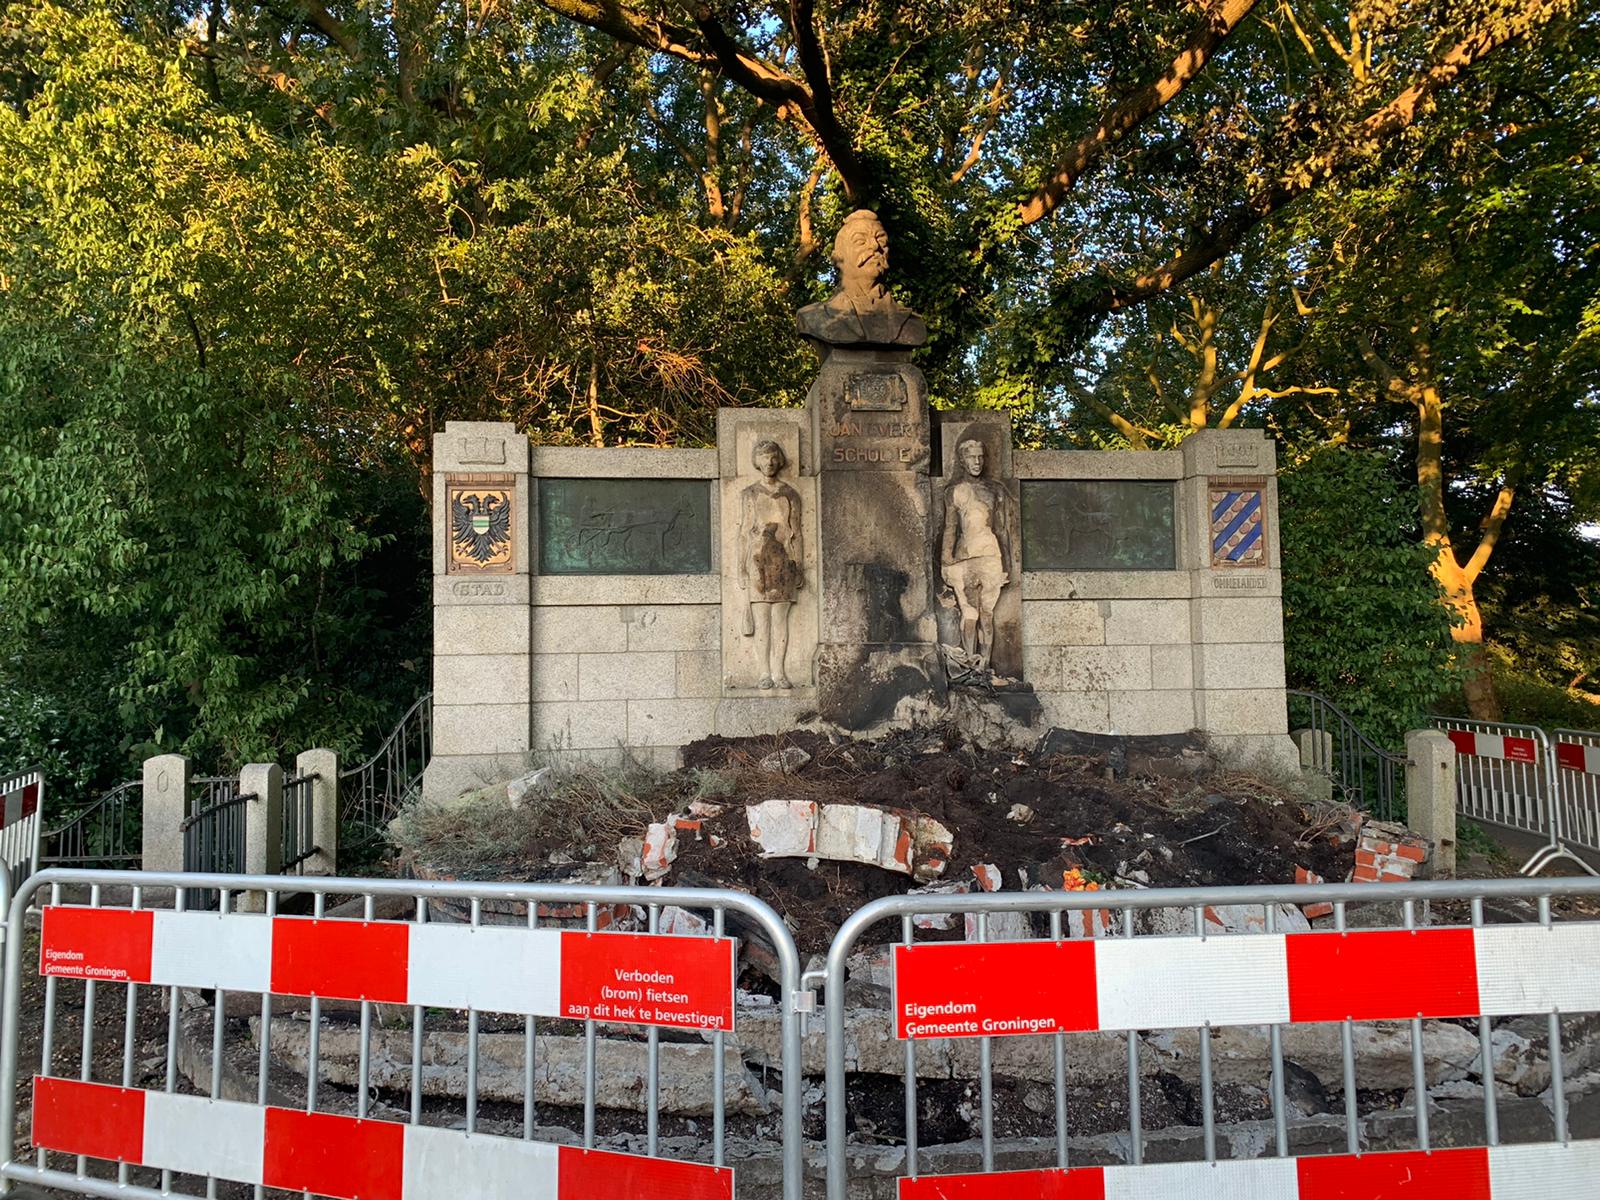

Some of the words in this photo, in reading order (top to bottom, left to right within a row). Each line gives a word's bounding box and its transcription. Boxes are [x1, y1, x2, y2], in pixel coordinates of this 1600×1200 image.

[829, 422, 862, 438] JAN
[459, 583, 505, 597] STAD
[45, 949, 84, 961] Eigendom
[45, 963, 83, 975] Gemeente
[85, 965, 127, 979] Groningen
[614, 968, 674, 984] Verboden
[601, 986, 643, 1002] (brom)
[646, 988, 689, 1004] fietsen
[568, 1003, 590, 1015] aan
[593, 1004, 610, 1017] dit
[613, 1006, 635, 1018] hek
[639, 1008, 651, 1019] te
[655, 1008, 724, 1027] bevestigen
[905, 1001, 977, 1019] Eigendom
[906, 1021, 978, 1035] Gemeente
[982, 1016, 1055, 1032] Groningen
